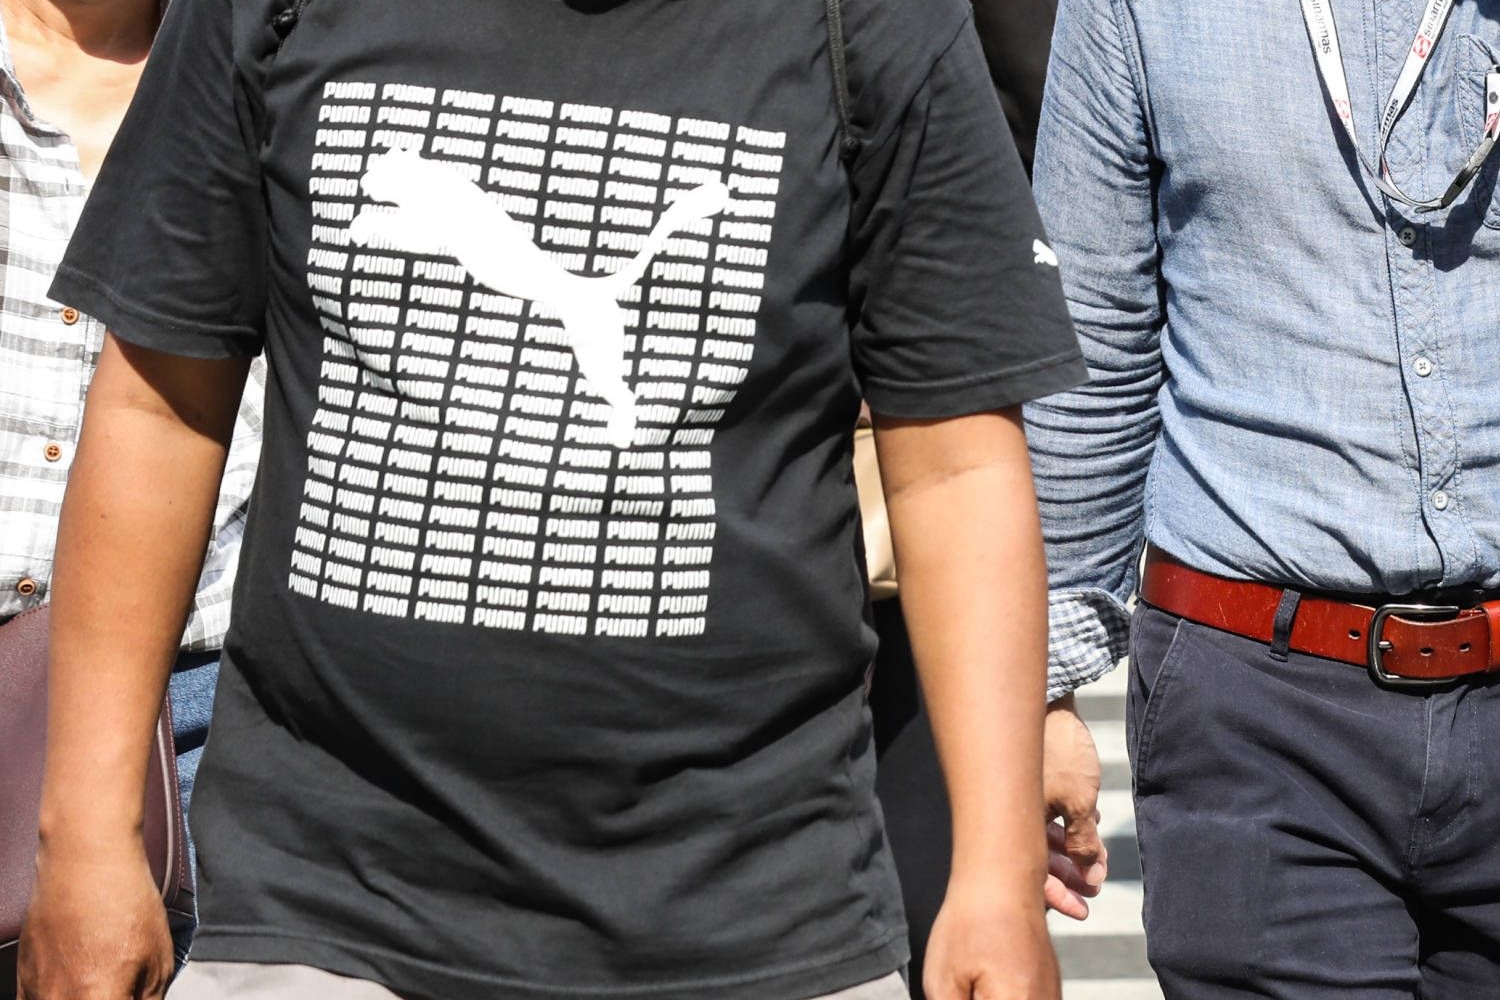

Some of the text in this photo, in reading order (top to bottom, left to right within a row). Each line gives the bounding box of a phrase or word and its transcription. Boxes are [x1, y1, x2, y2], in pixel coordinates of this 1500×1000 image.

[318, 105, 783, 172] PUMA PUMA PUMA PUMA PUMA PUMA PUMA PUMA
[323, 82, 786, 148] PUMA PUMA PUMA PUMA PUMA PUMA PUMA PUMA
[311, 153, 362, 172] PUMA
[488, 167, 541, 191] PUMA
[547, 175, 599, 198] PUMA
[604, 181, 657, 204] PUMA
[723, 199, 776, 218] PUMA
[315, 129, 780, 195] PUMA PUMA PUMA PUMA PUMA PUMA
[309, 178, 358, 196] PUMA
[544, 200, 595, 222] PUMA
[600, 206, 653, 228] PUMA
[719, 221, 772, 242] PUMA
[312, 201, 355, 221] PUMA
[541, 225, 591, 247] PUMA
[715, 244, 768, 266] PUMA
[307, 248, 348, 271] PUMA
[352, 255, 405, 276] PUMA
[413, 261, 466, 284] PUMA
[649, 286, 702, 307] PUMA
[709, 291, 761, 312] PUMA
[652, 262, 705, 283] PUMA
[712, 267, 764, 289] PUMA
[348, 302, 400, 325] PUMA
[405, 309, 459, 332] PUMA
[465, 316, 519, 340] PUMA
[642, 335, 696, 356] PUMA
[702, 339, 754, 361] PUMA
[350, 279, 402, 300] PUMA
[409, 285, 463, 308] PUMA
[469, 292, 524, 316] PUMA
[646, 311, 699, 331] PUMA
[706, 315, 756, 336] PUMA
[397, 355, 450, 378] PUMA
[455, 363, 509, 387] PUMA
[515, 371, 569, 394] PUMA
[634, 382, 687, 401] PUMA
[460, 340, 514, 363] PUMA
[519, 347, 573, 371] PUMA
[638, 358, 692, 378] PUMA
[357, 392, 398, 416] PUMA
[445, 407, 499, 431] PUMA
[504, 416, 559, 441] PUMA
[450, 385, 504, 410] PUMA
[510, 394, 564, 417] PUMA
[307, 431, 712, 494] PUMA PUMA PUMA PUMA PUMA PUMA PUMA PUMA
[312, 408, 711, 470] PUMA PUMA PUMA PUMA PUMA PUMA PUMA PUMA
[304, 479, 716, 540] PUMA PUMA PUMA PUMA PUMA PUMA PUMA PUMA
[339, 464, 379, 489] PUMA
[383, 473, 428, 497] PUMA
[434, 481, 483, 503] PUMA
[490, 487, 542, 510] PUMA
[550, 495, 603, 513] PUMA
[611, 500, 664, 515] PUMA
[670, 498, 715, 517] PUMA
[295, 526, 710, 589] PUMA PUMA PUMA PUMA PUMA PUMA PUMA PUMA
[300, 503, 712, 565] PUMA PUMA PUMA PUMA PUMA PUMA PUMA PUMA
[289, 573, 705, 637] PUMA PUMA PUMA PUMA PUMA PUMA PUMA PUMA
[291, 550, 708, 614] PUMA PUMA PUMA PUMA PUMA PUMA PUMA PUMA
